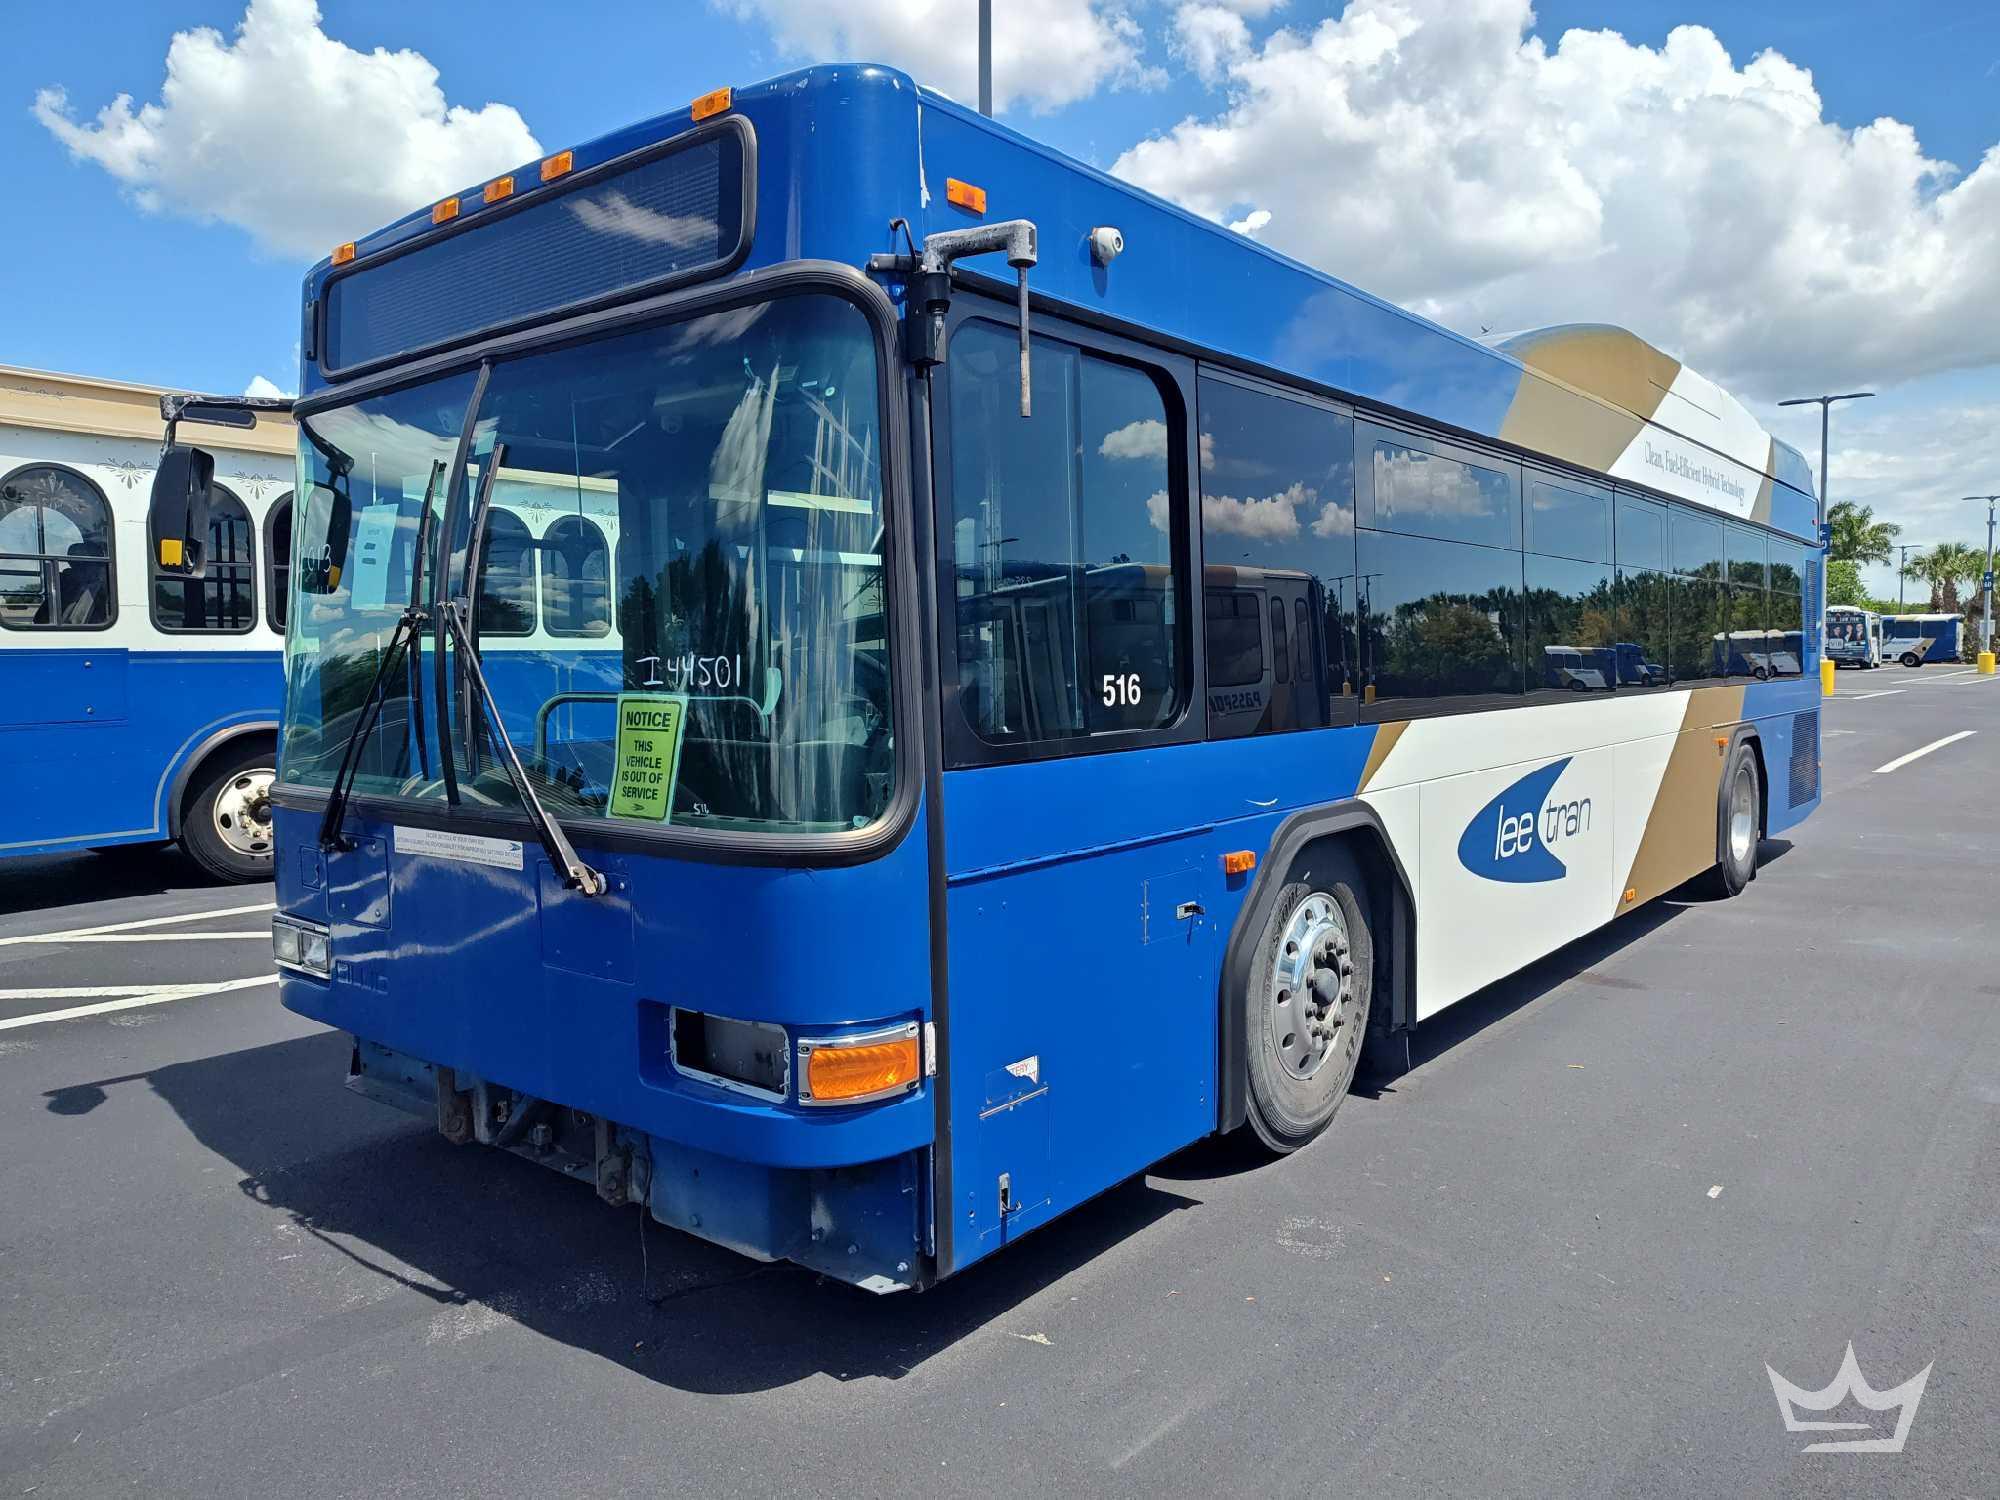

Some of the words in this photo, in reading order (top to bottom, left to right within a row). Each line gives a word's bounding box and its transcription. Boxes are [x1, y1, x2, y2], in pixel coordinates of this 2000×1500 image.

[1103, 674, 1142, 707] 516
[626, 711, 671, 728] NOTICE
[634, 740, 653, 752] THIS
[626, 756, 662, 769] VEHICLE
[622, 771, 630, 781] IS
[630, 771, 647, 783] OUT
[649, 772, 663, 784] OF
[622, 786, 659, 800] SERVICE
[1494, 804, 1534, 860] lee
[1546, 798, 1592, 843] tran
